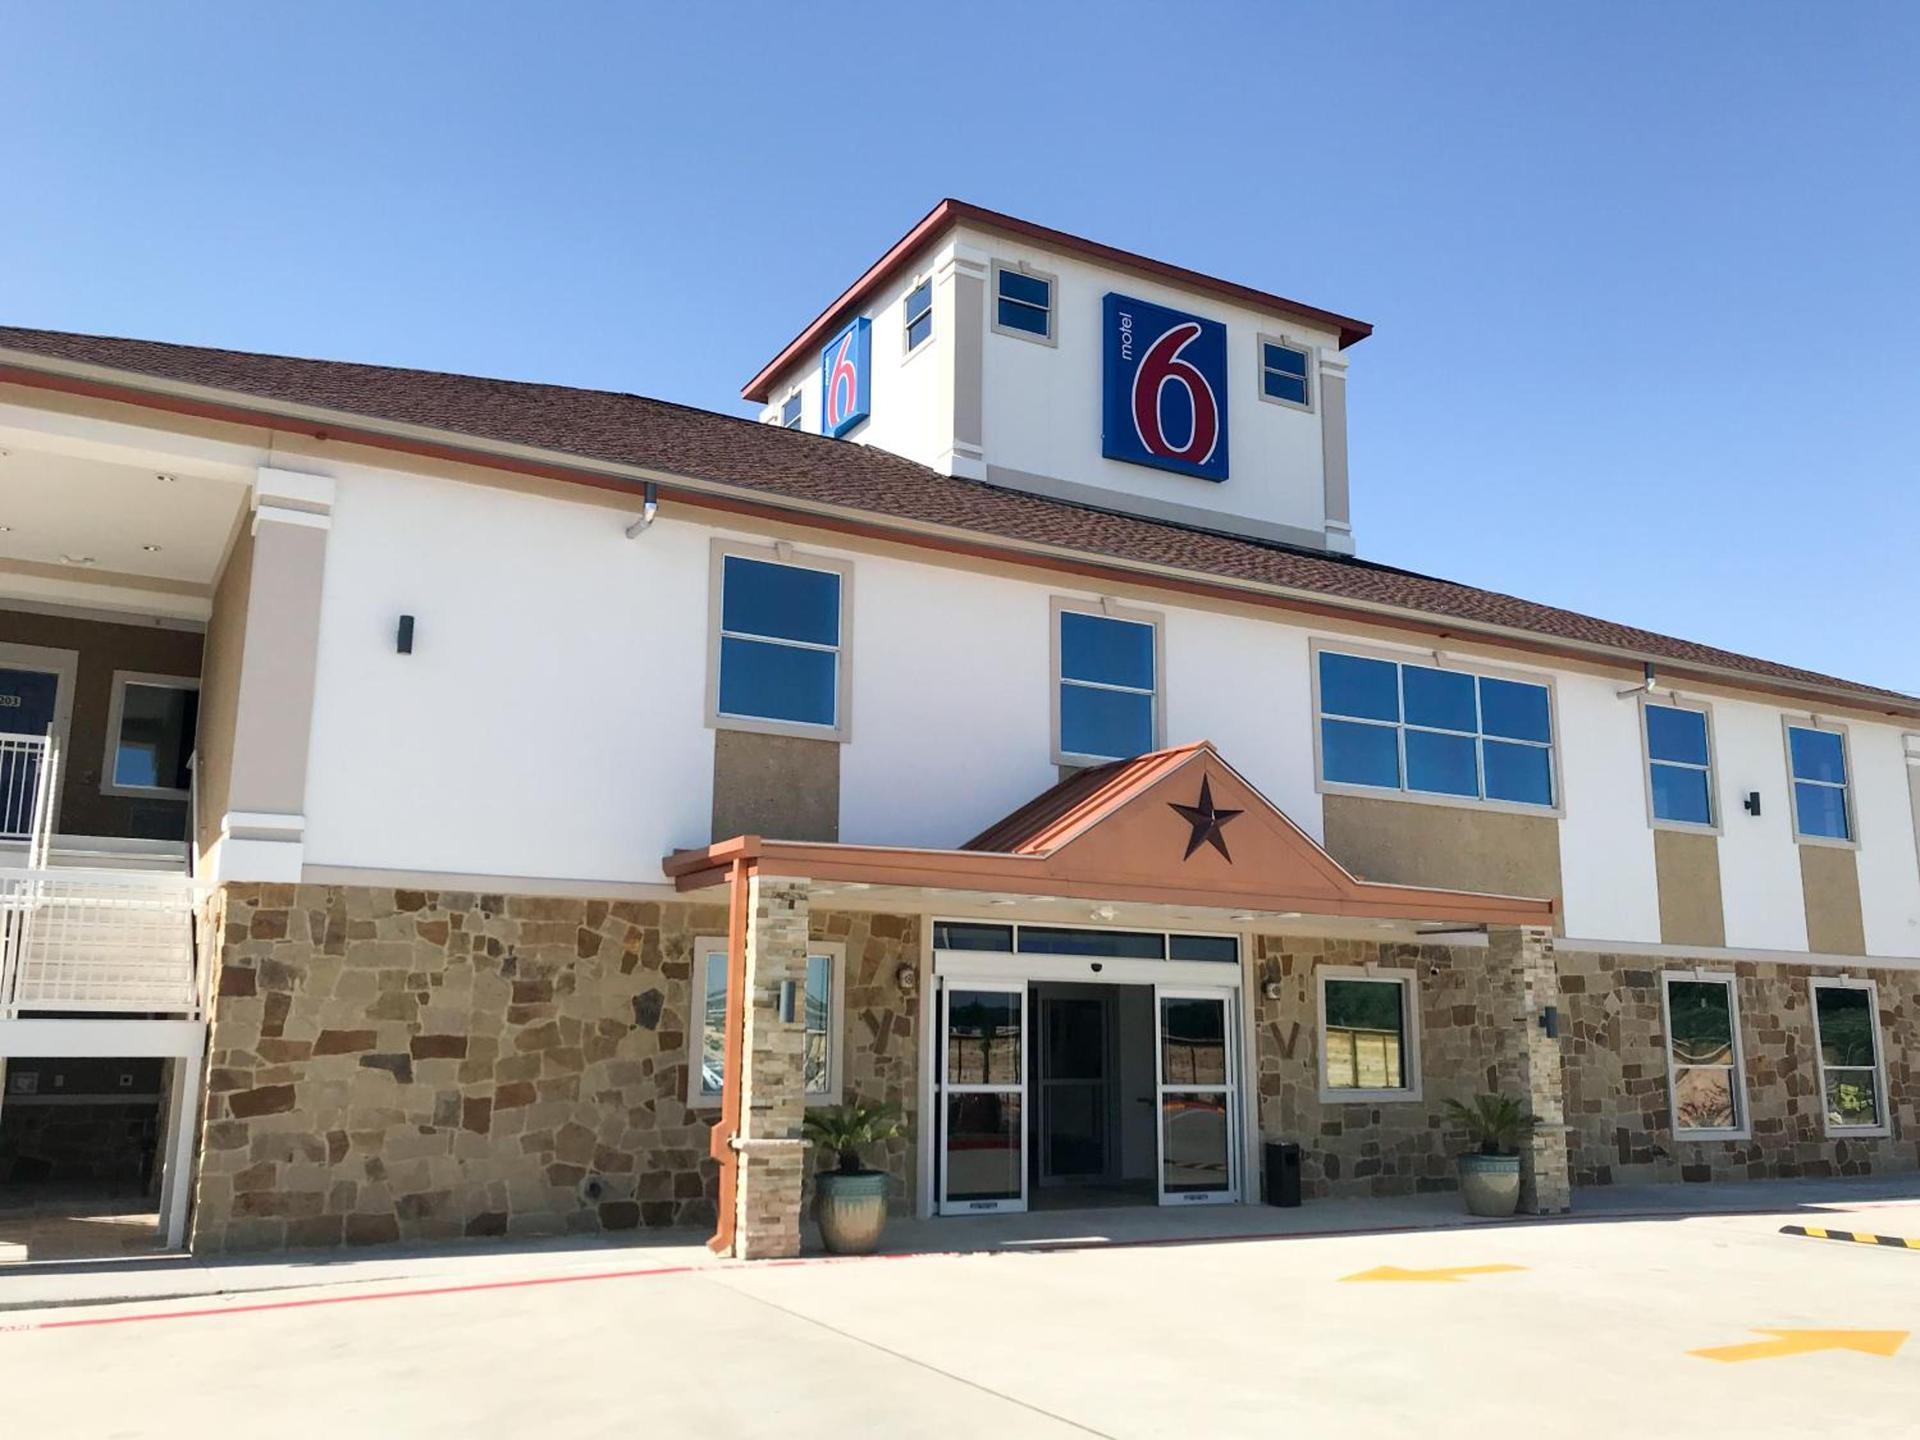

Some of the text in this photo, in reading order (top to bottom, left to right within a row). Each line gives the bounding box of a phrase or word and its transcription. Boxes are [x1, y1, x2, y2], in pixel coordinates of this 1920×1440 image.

[828, 331, 856, 429] 6
[1119, 312, 1132, 361] motel
[1131, 322, 1219, 465] 6
